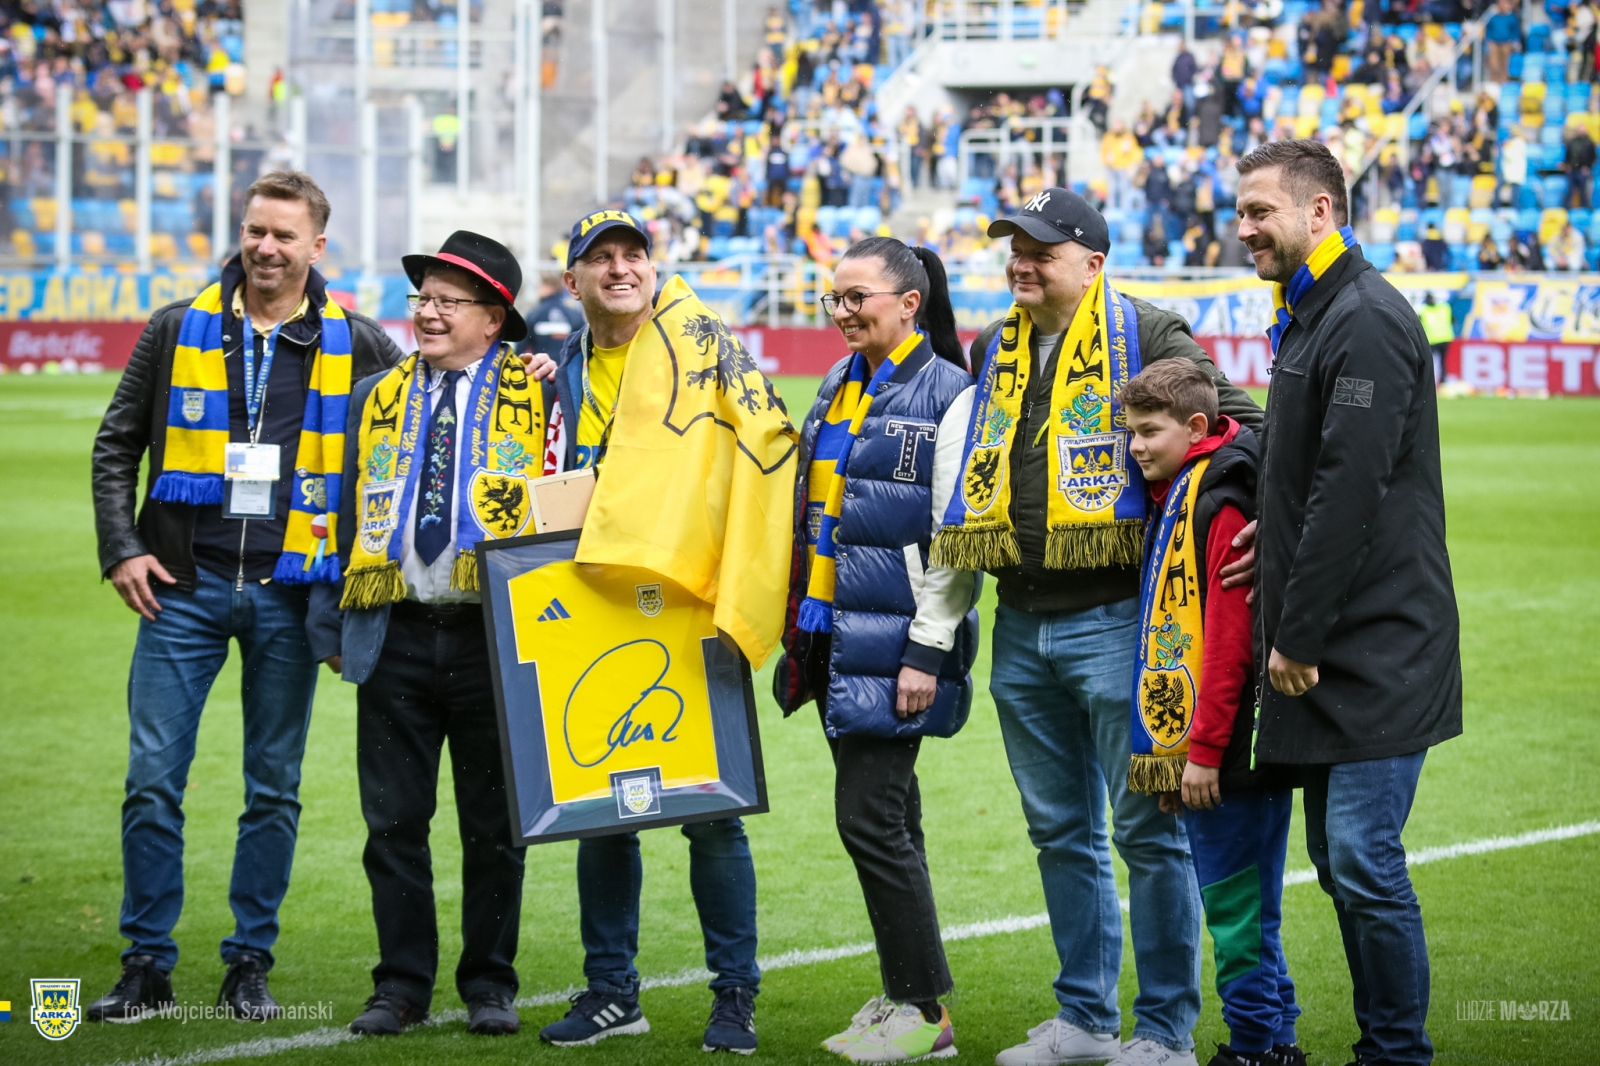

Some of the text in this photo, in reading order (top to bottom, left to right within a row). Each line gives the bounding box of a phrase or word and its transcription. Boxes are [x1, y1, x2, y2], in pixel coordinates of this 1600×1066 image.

[581, 209, 636, 237] ARKA
[1461, 343, 1600, 394] BET
[1067, 474, 1119, 488] ARKA
[1068, 485, 1118, 508] GDYNIA
[363, 518, 392, 531] ARKA
